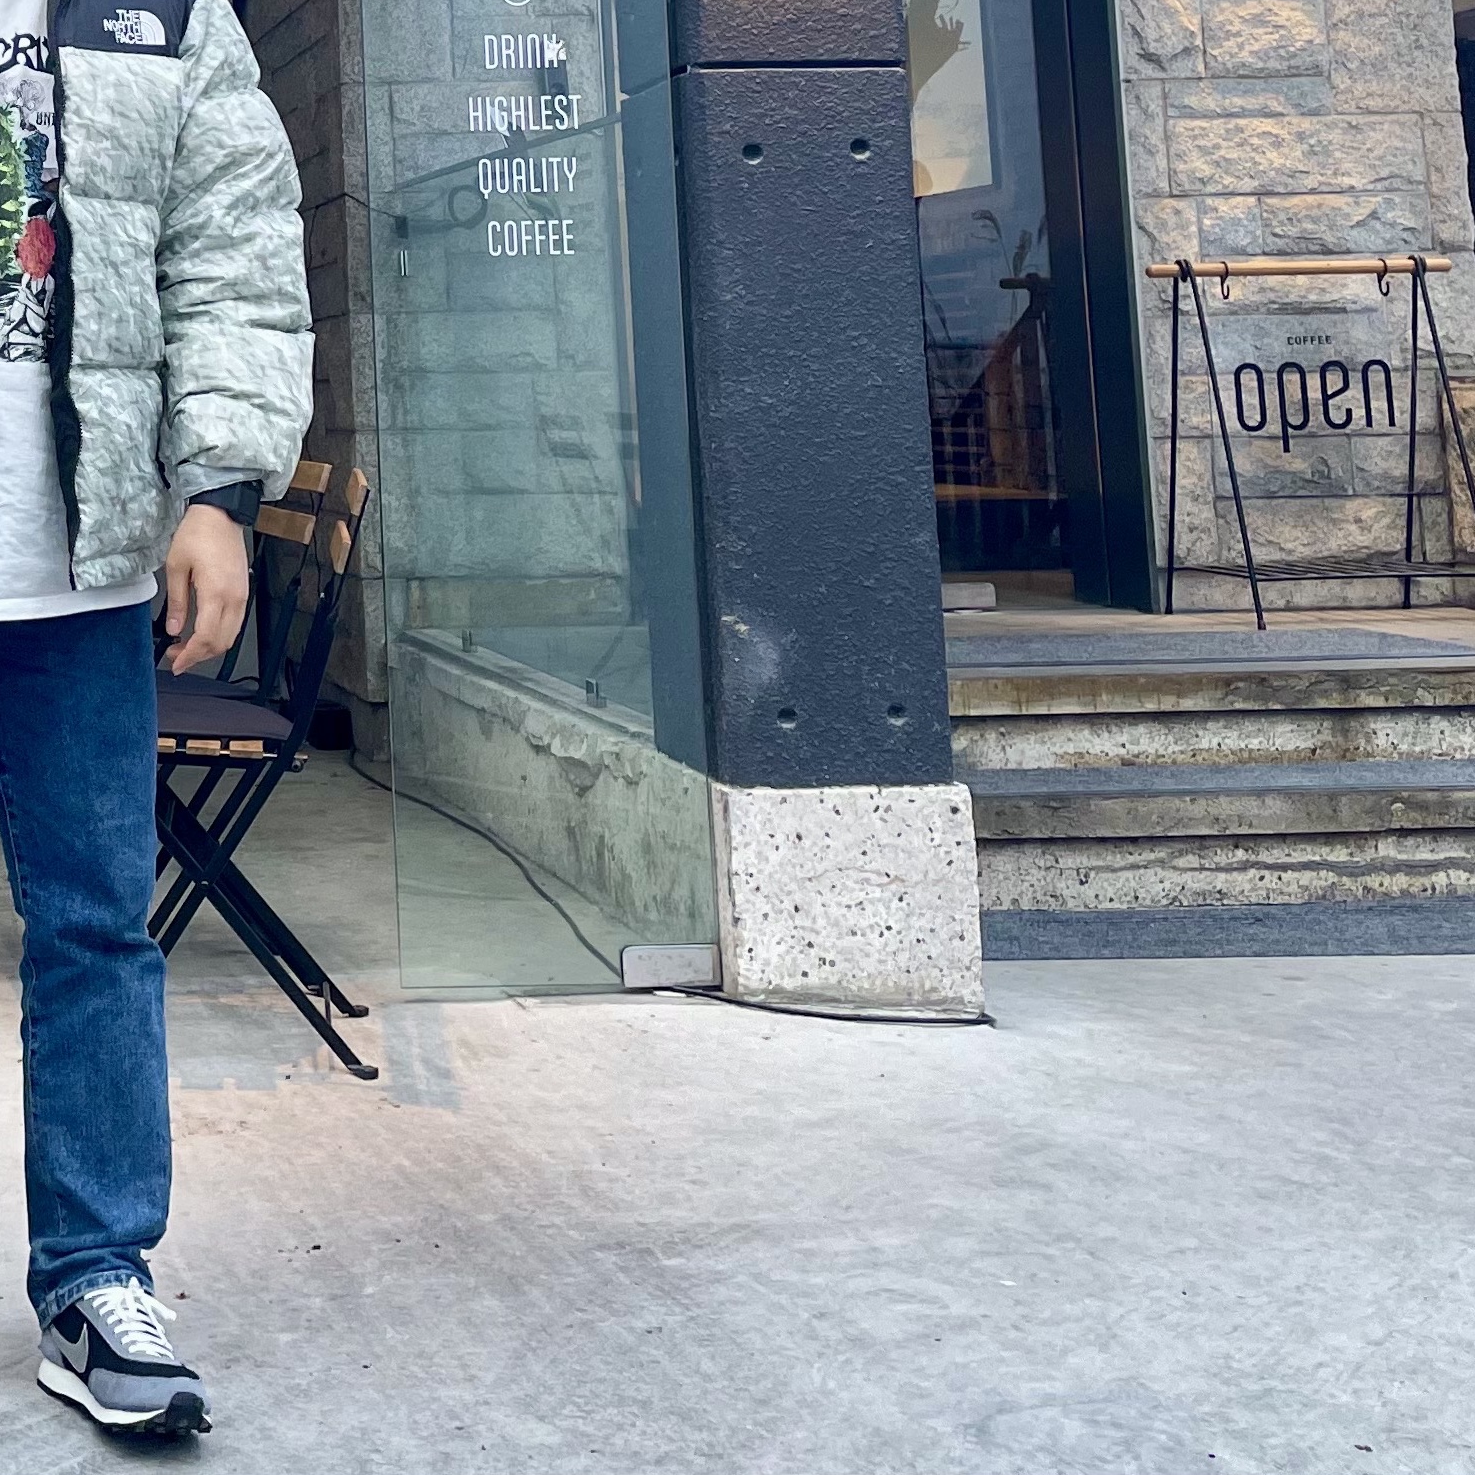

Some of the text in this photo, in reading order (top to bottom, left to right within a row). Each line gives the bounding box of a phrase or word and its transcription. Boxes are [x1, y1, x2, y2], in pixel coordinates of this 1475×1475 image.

[103, 18, 142, 34] NORTH
[116, 9, 140, 22] THE
[115, 32, 143, 45] FACE
[484, 33, 559, 70] DRINK
[468, 94, 582, 132] HIGHLEST
[477, 156, 578, 200] QUALITY
[487, 219, 576, 257] COFFEE
[1286, 334, 1332, 345] COFFEE
[1233, 359, 1396, 453] open
